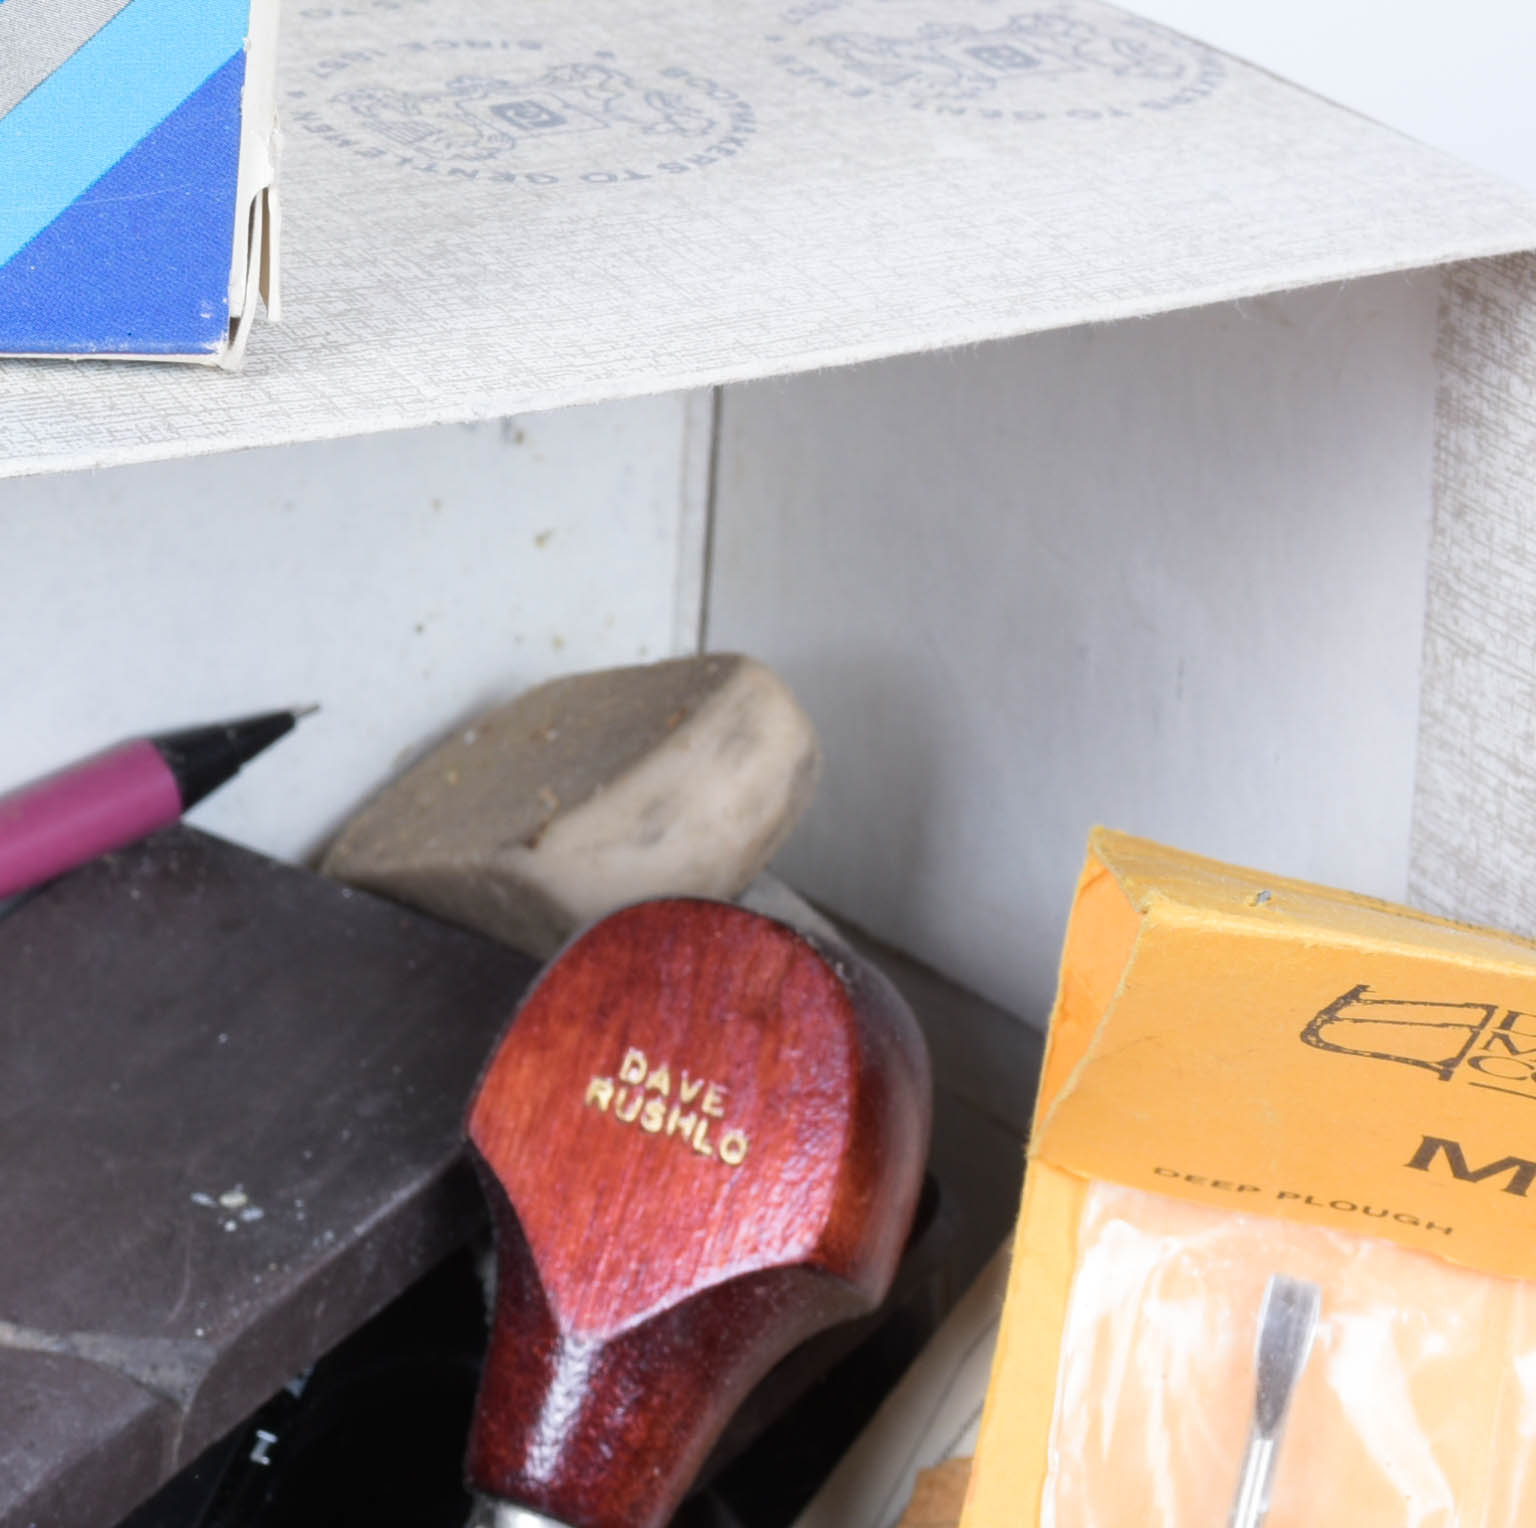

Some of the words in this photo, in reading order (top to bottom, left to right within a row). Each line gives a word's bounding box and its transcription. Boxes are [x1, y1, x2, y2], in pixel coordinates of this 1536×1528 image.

[619, 1046, 729, 1118] DAVE
[584, 1074, 749, 1165] RUSHLO
[1152, 1166, 1261, 1193] DEEP
[1275, 1190, 1454, 1236] PLOUGH
